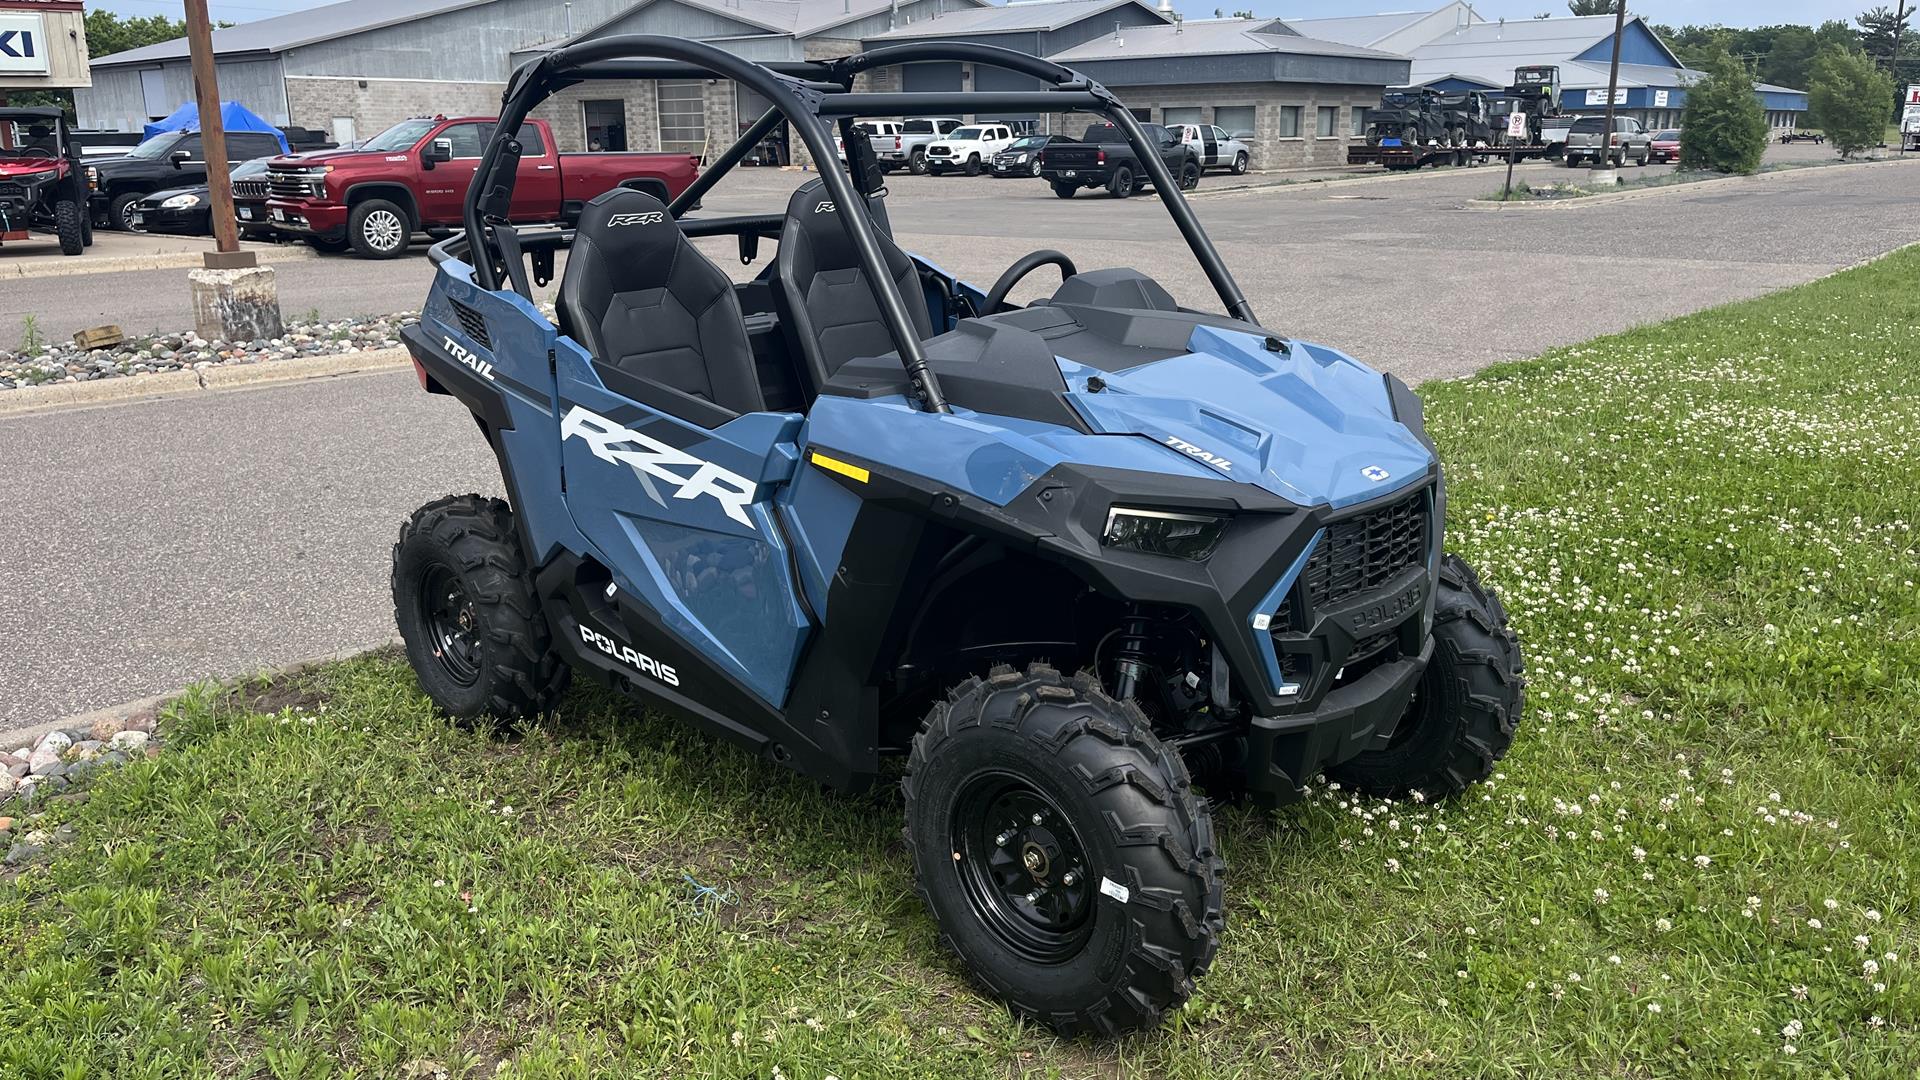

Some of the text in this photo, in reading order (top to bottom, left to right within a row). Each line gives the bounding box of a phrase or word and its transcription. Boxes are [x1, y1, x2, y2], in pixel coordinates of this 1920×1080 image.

[607, 211, 664, 228] RZR
[443, 335, 496, 381] TRAIL
[560, 404, 758, 531] RZR
[1165, 435, 1233, 471] TRAIL
[1352, 583, 1422, 634] POLARIS
[578, 623, 680, 687] POLARIS
